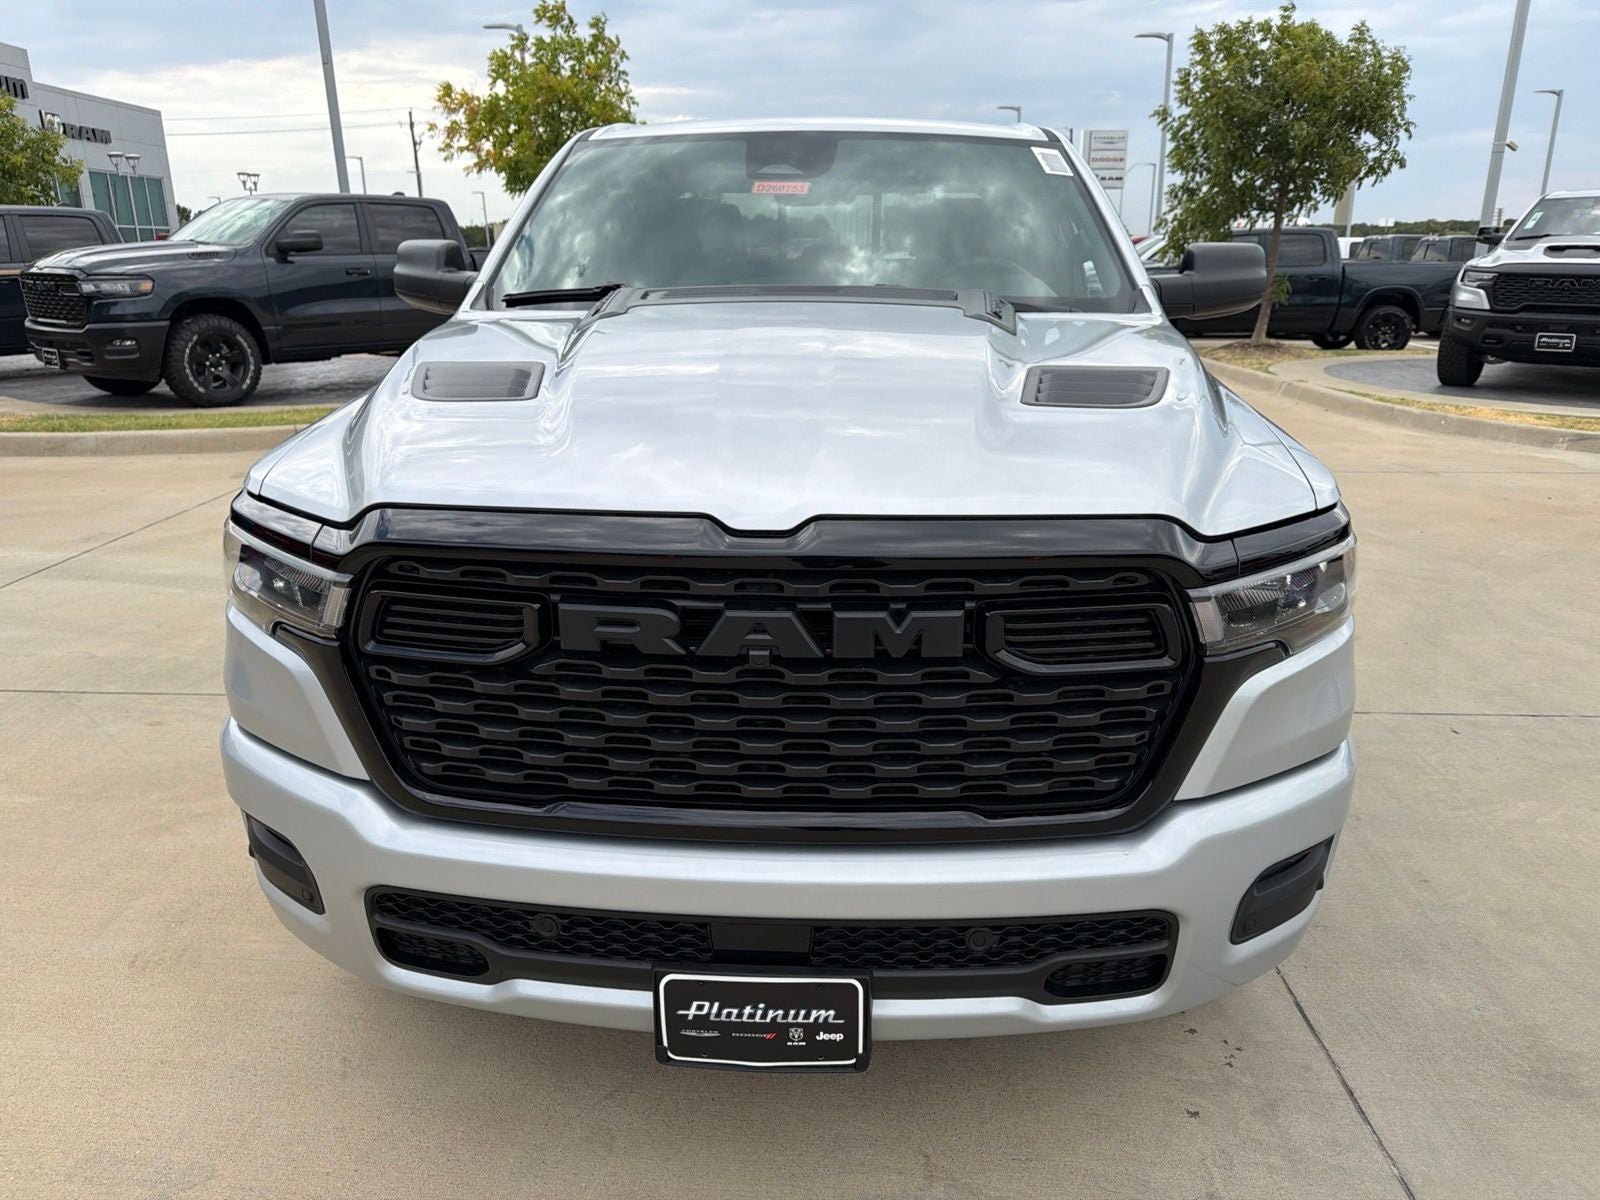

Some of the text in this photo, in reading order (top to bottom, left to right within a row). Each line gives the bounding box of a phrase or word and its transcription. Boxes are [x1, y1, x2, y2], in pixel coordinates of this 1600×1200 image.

[62, 122, 112, 144] RAM
[756, 184, 805, 192] D260753
[558, 602, 966, 658] RAM
[676, 1001, 845, 1024] Platinum
[815, 1031, 845, 1043] Jeep
